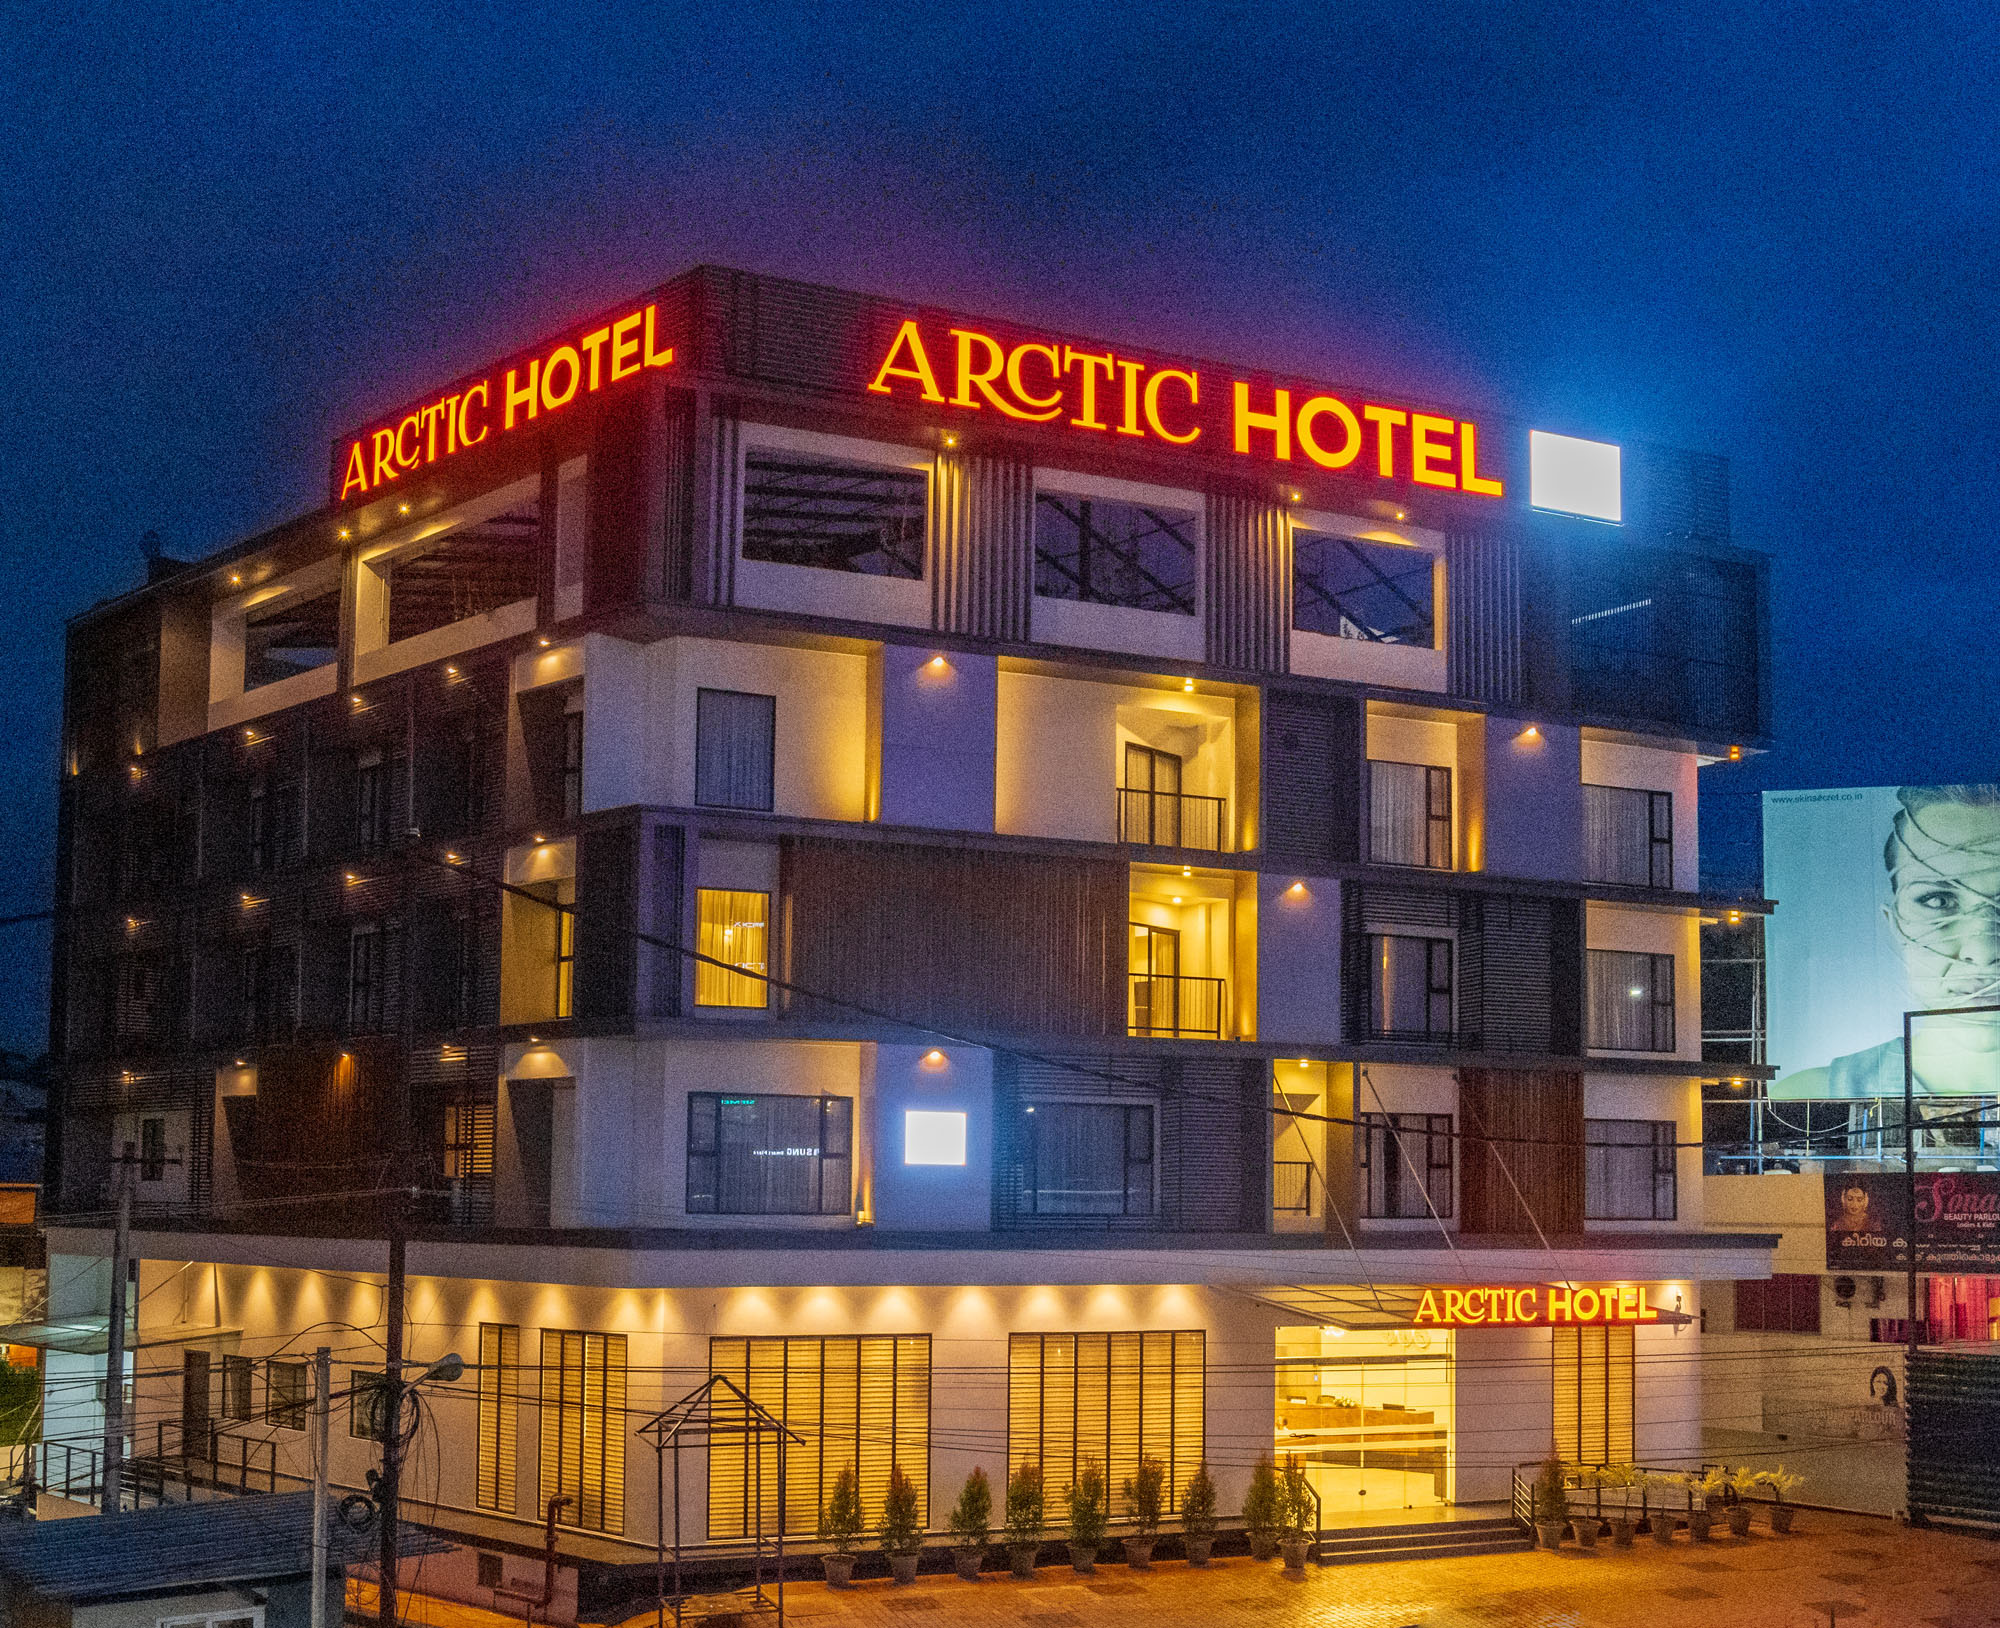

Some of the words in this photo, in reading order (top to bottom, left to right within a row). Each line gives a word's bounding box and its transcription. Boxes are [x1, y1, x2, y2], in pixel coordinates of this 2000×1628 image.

[341, 380, 488, 500] ARCTIC
[504, 304, 674, 430] HOTEL
[868, 320, 1201, 444] ARCTIC
[1234, 381, 1503, 497] HOTEL
[1943, 1213, 1973, 1221] BEAUTY
[1414, 1288, 1538, 1324] ARCTIC
[1548, 1287, 1658, 1321] HOTEL
